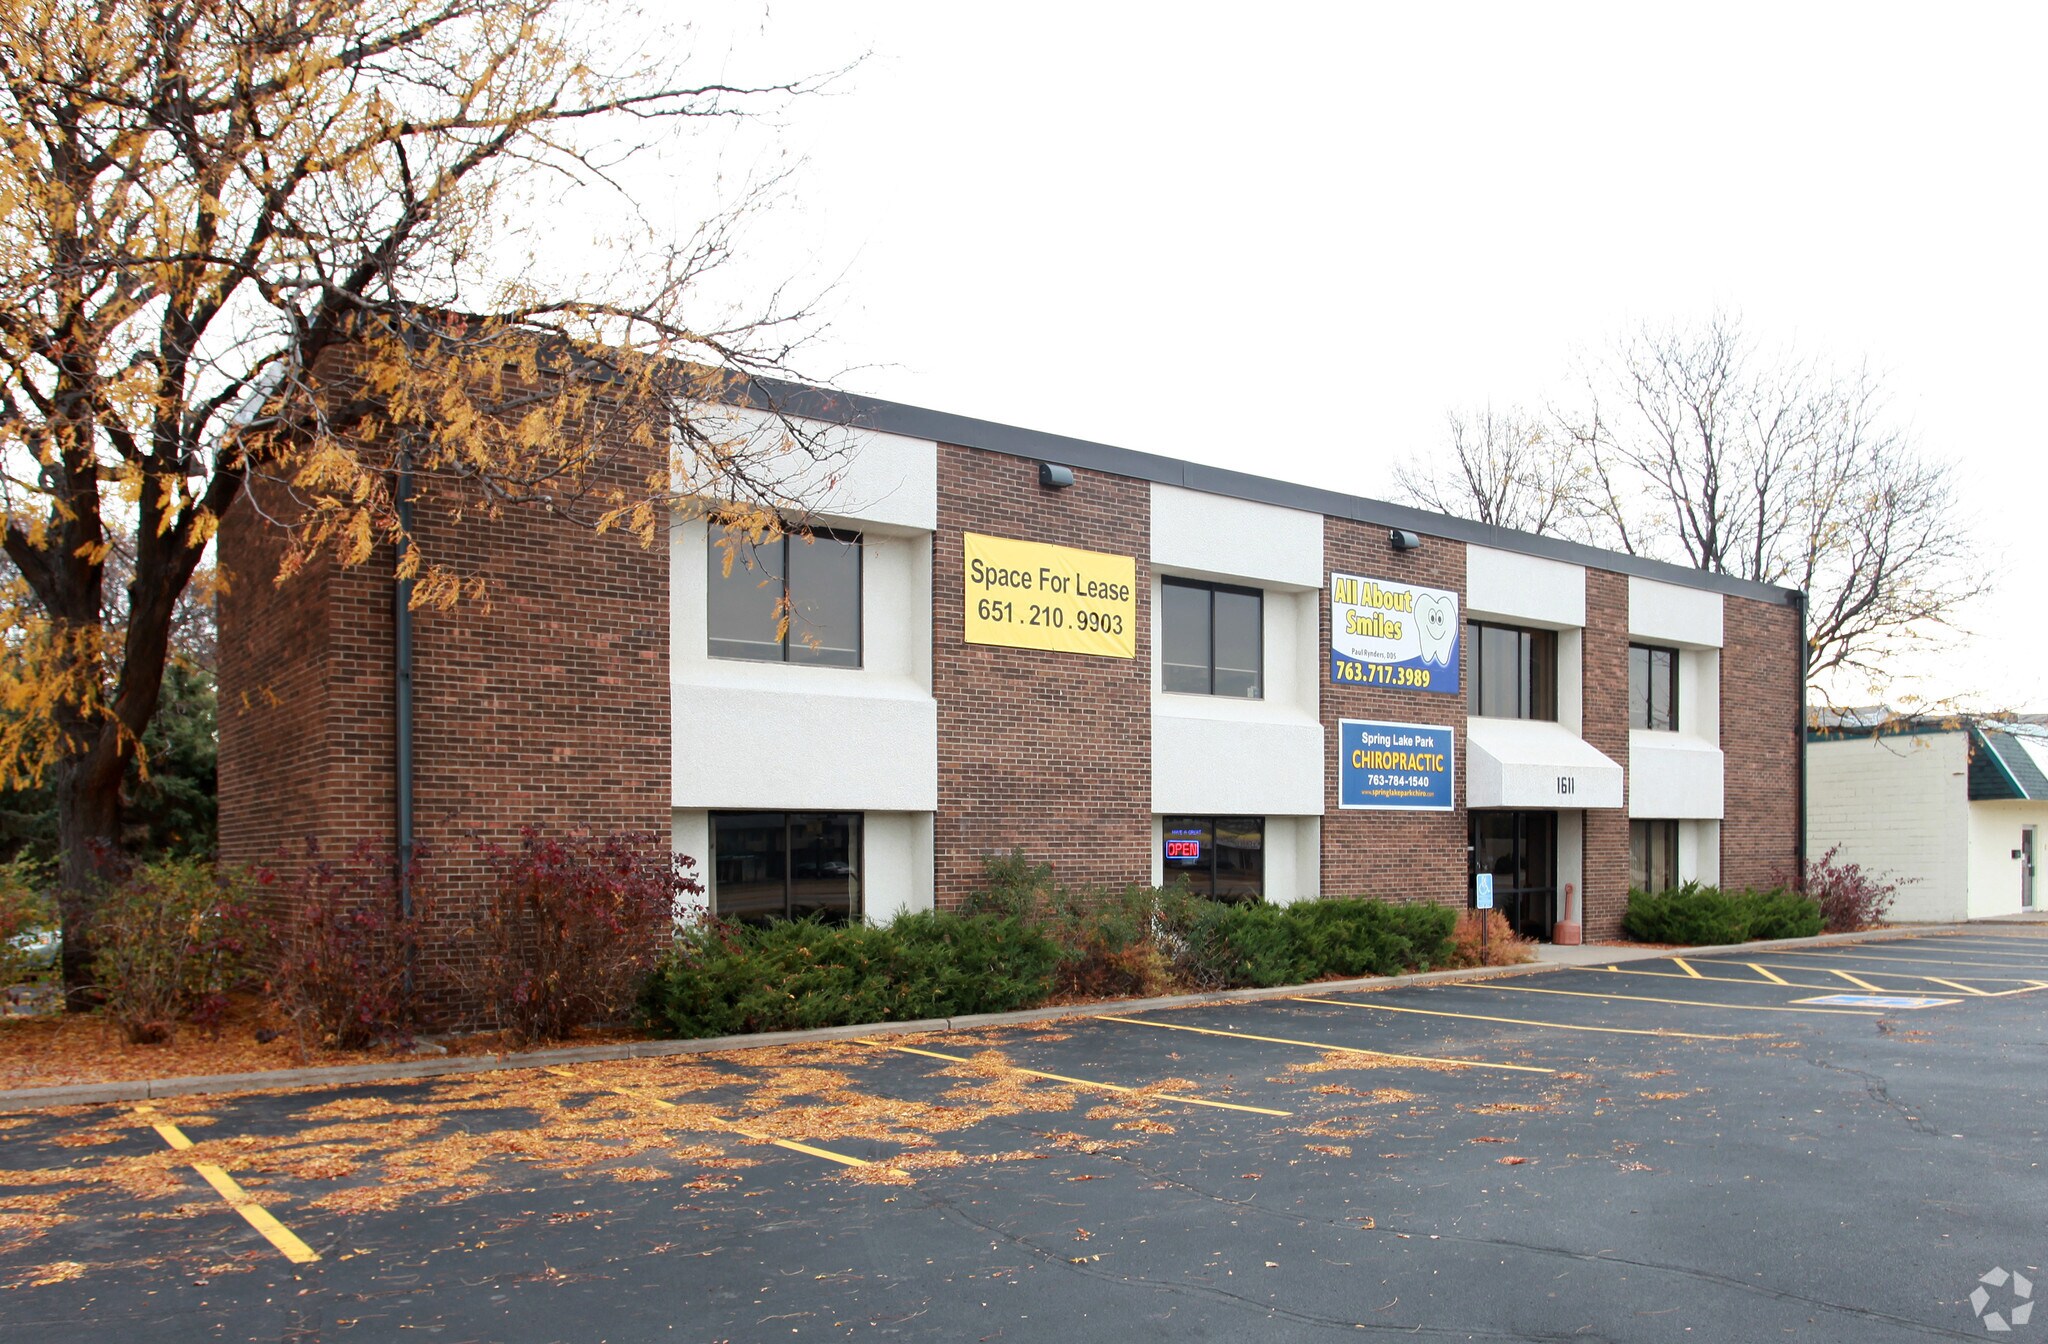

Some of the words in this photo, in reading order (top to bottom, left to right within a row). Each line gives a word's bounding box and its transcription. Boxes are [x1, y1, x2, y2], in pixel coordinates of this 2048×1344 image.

[970, 558, 1032, 591] Space
[1039, 567, 1070, 594] For
[1076, 572, 1130, 602] Lease
[1334, 577, 1359, 606] All
[1360, 581, 1413, 614] About
[1345, 608, 1403, 640] Smiles
[1351, 647, 1364, 656] Paul
[1386, 651, 1397, 660] DDS
[1336, 660, 1431, 688] 763.717.3989
[1361, 731, 1391, 748] Spring
[1393, 734, 1413, 747] Lake
[1415, 735, 1434, 748] Park
[1352, 749, 1444, 773] CHIROPRACTIC
[1367, 774, 1430, 787] 763-784-1540
[1557, 777, 1575, 794] 1611
[1168, 842, 1197, 856] OPEN
